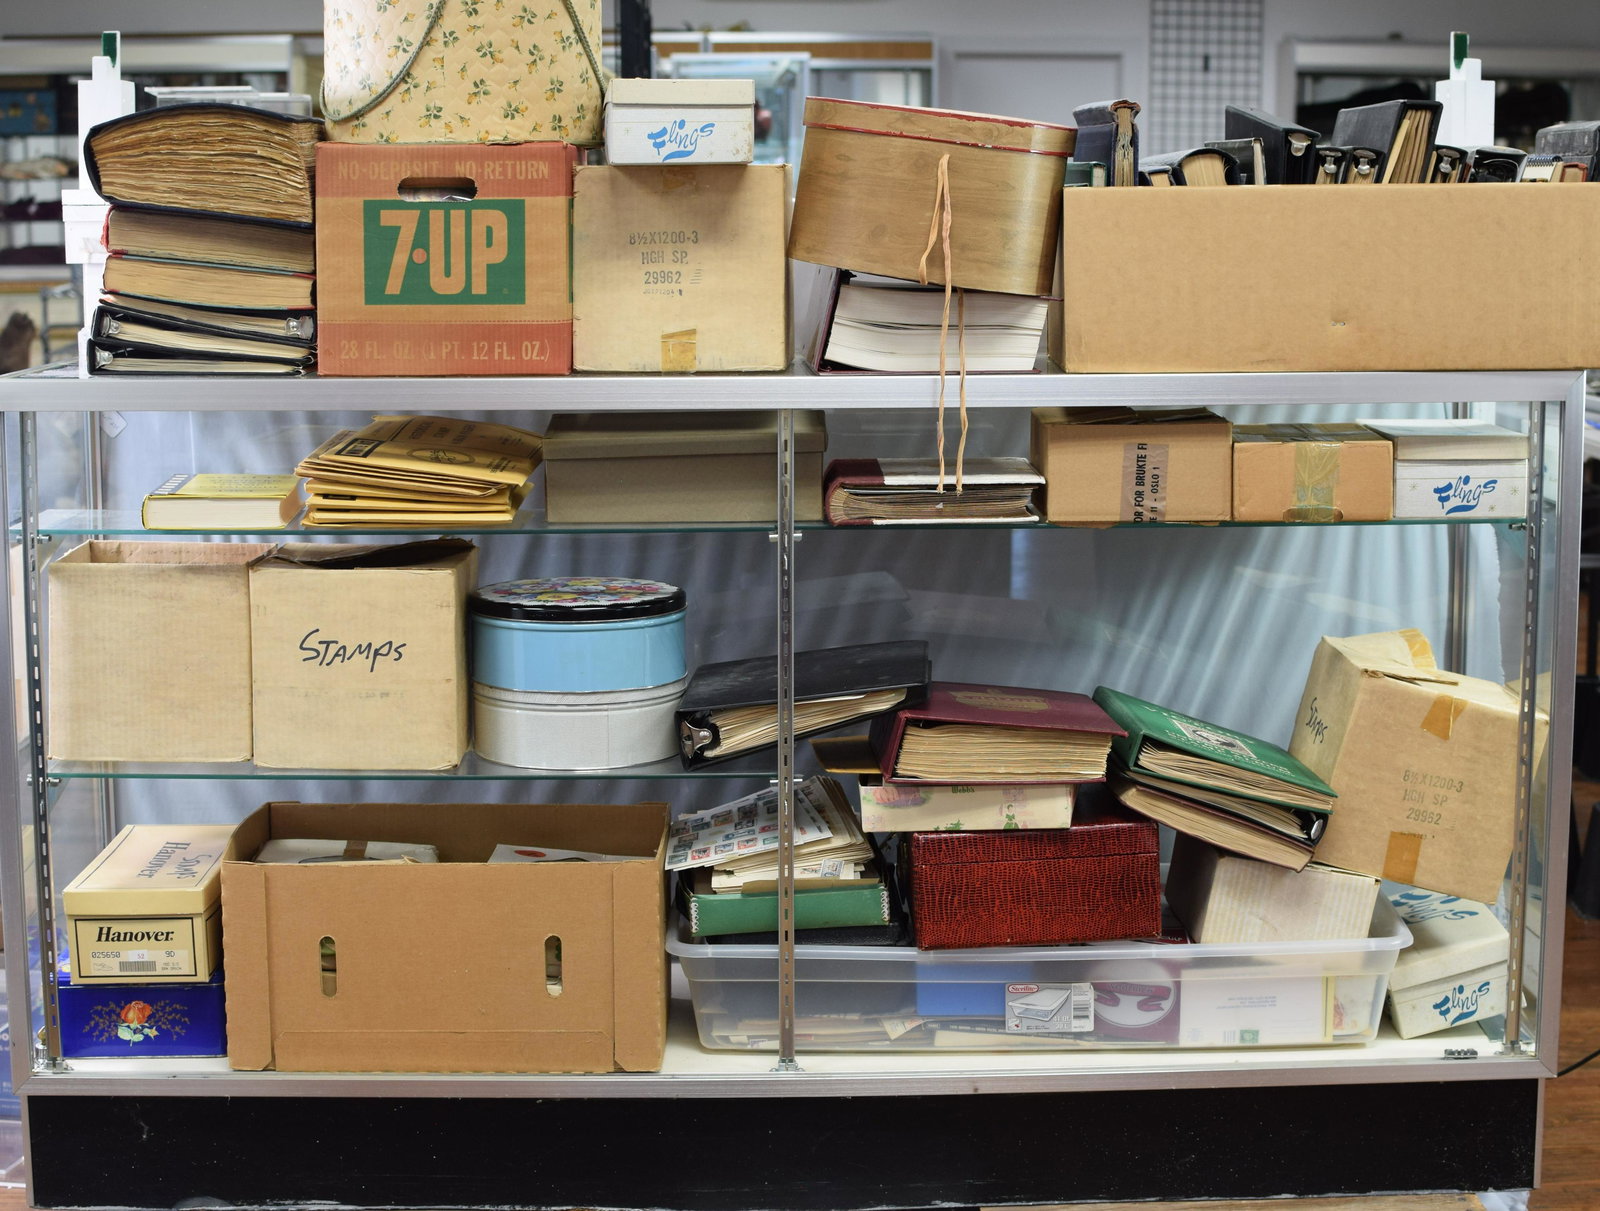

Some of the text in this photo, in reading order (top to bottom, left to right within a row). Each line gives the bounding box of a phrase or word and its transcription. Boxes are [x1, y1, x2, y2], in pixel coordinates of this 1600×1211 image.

[647, 119, 716, 162] Flings
[641, 250, 665, 265] HGH
[644, 270, 682, 285] 29962
[340, 340, 358, 359] 28
[472, 341, 488, 360] 12
[1135, 453, 1147, 487] BRUKTE
[1150, 474, 1160, 494] OSLO
[1134, 490, 1145, 507] FOR
[1433, 475, 1498, 515] Flings
[1406, 807, 1442, 825] 29962
[137, 841, 191, 878] Hanover
[1432, 981, 1490, 1026] Flings
